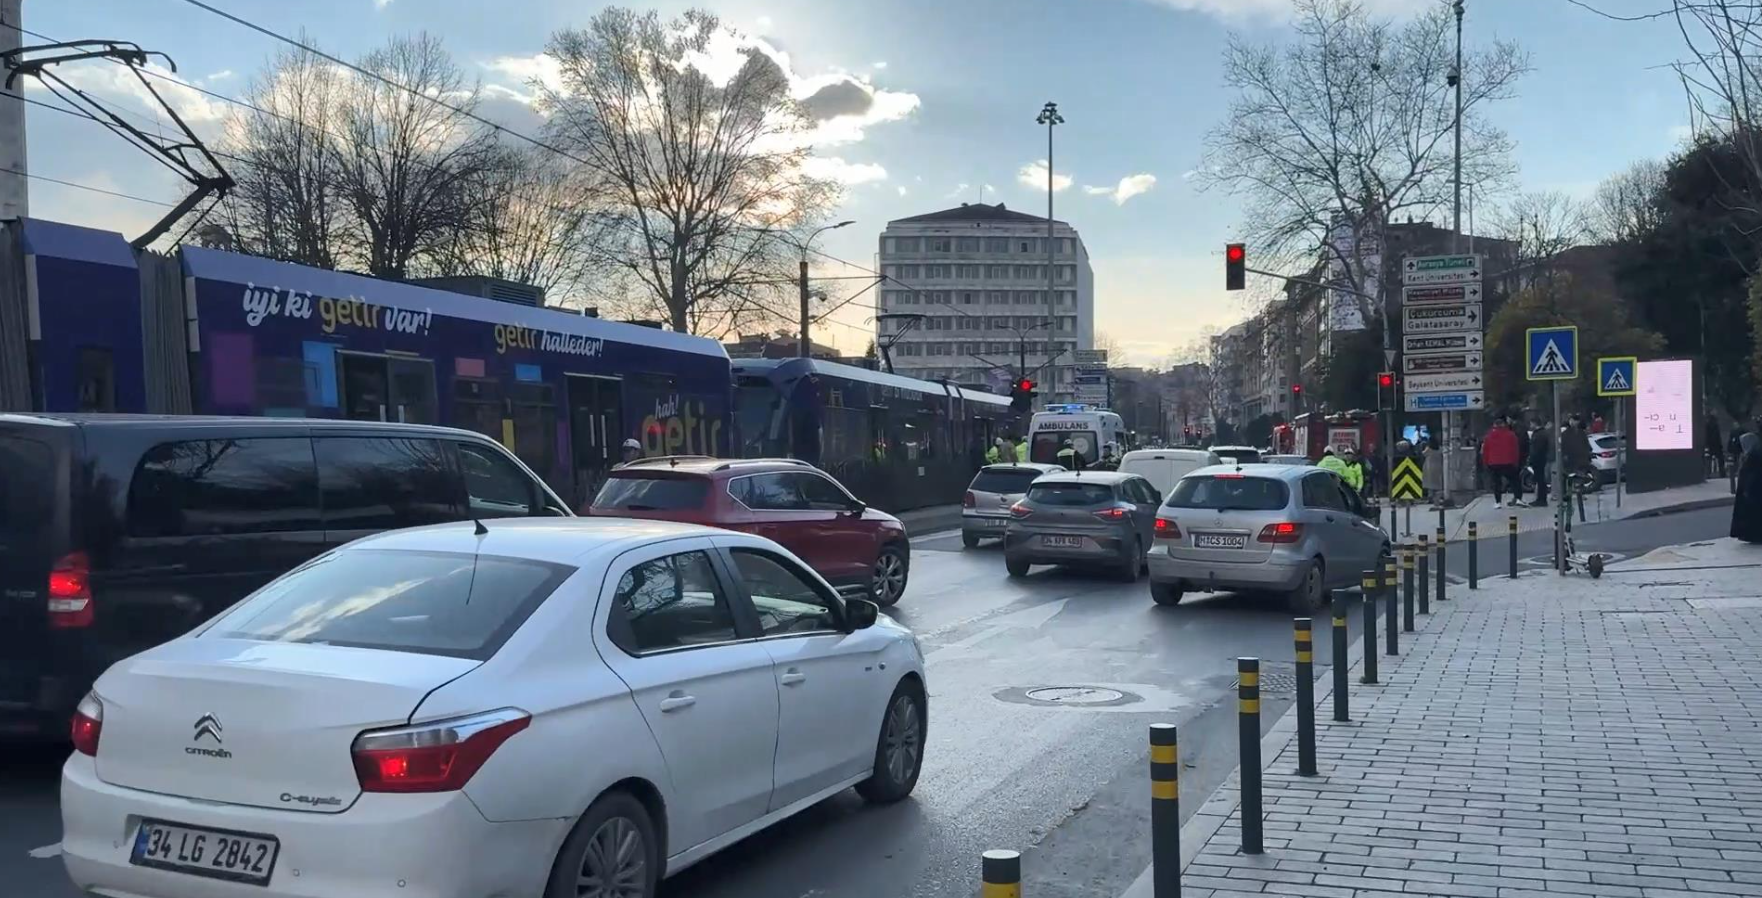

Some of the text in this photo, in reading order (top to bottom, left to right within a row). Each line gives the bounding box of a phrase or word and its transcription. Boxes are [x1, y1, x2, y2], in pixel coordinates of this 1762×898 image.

[243, 282, 432, 336] iyi ki getir var!
[1408, 320, 1464, 330] Galatasaray
[494, 321, 604, 357] getir halleder!
[655, 394, 679, 420] hah!
[1038, 422, 1089, 430] AMBULANS
[1222, 537, 1242, 546] 1004
[147, 829, 269, 873] 34 LG 2842
